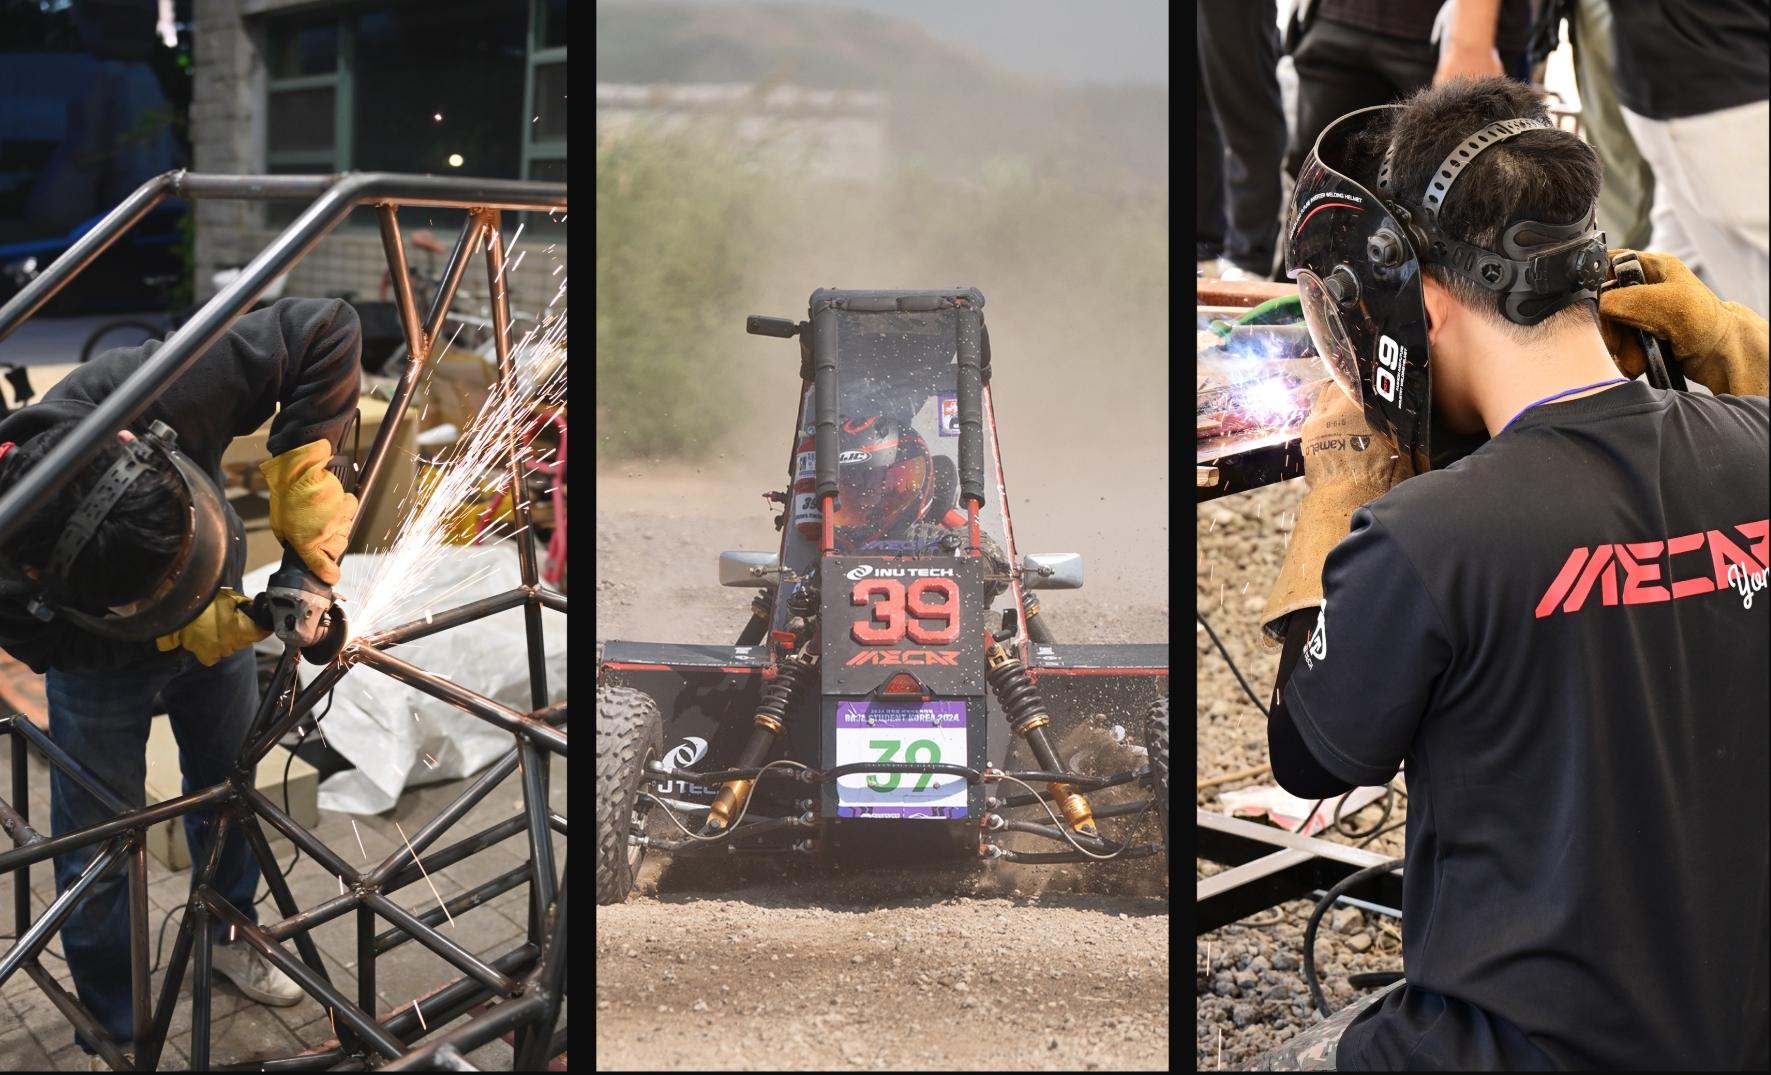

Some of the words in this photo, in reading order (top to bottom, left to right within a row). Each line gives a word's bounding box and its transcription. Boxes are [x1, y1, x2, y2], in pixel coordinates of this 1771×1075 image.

[874, 568, 905, 577] INU
[907, 568, 954, 577] TECH
[852, 579, 960, 645] 39
[846, 650, 961, 666] MECAR
[866, 739, 942, 793] 39
